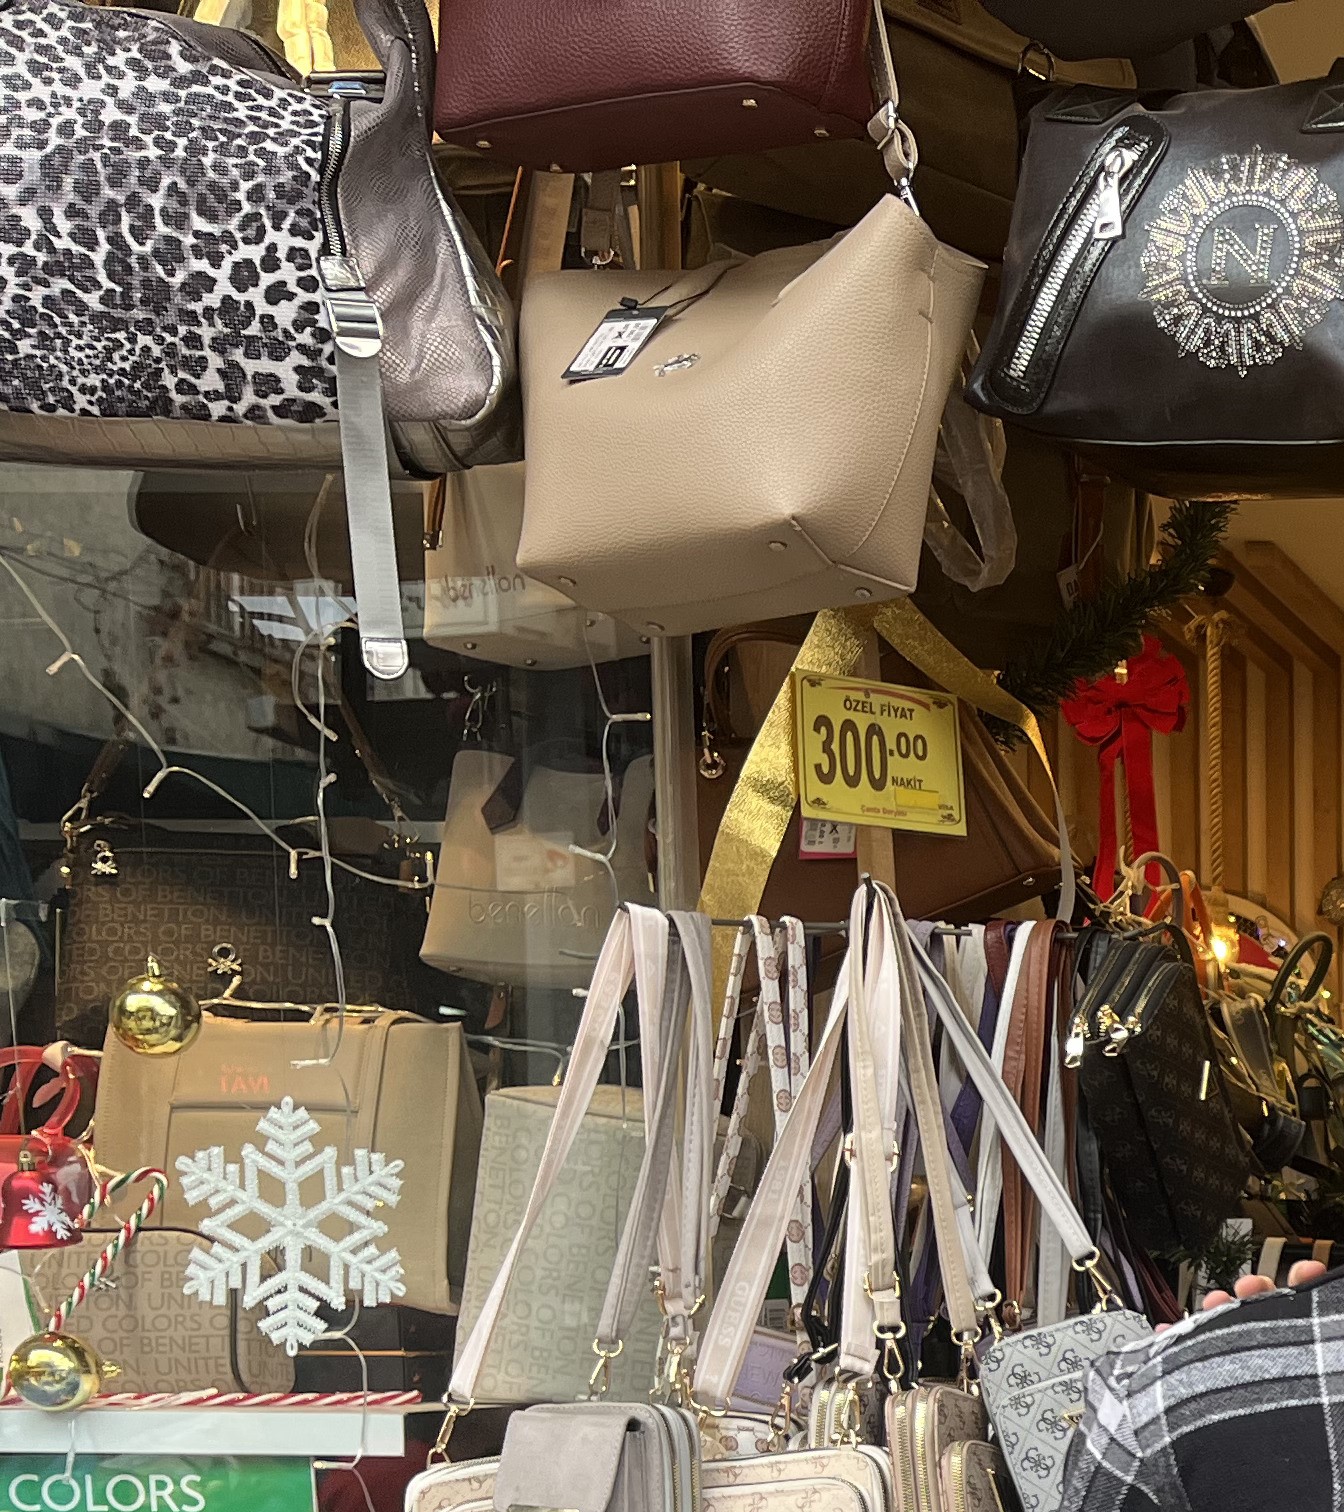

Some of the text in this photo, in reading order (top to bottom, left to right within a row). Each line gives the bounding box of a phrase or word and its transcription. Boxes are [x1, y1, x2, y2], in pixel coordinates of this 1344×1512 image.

[1206, 224, 1276, 288] N
[844, 696, 915, 721] ÖZEL FİYAT
[891, 776, 923, 790] NAKİT
[469, 884, 599, 928] benetton
[102, 1315, 195, 1334] COLORS
[719, 1281, 750, 1348] GUESS
[8, 1473, 206, 1512] COLORS
